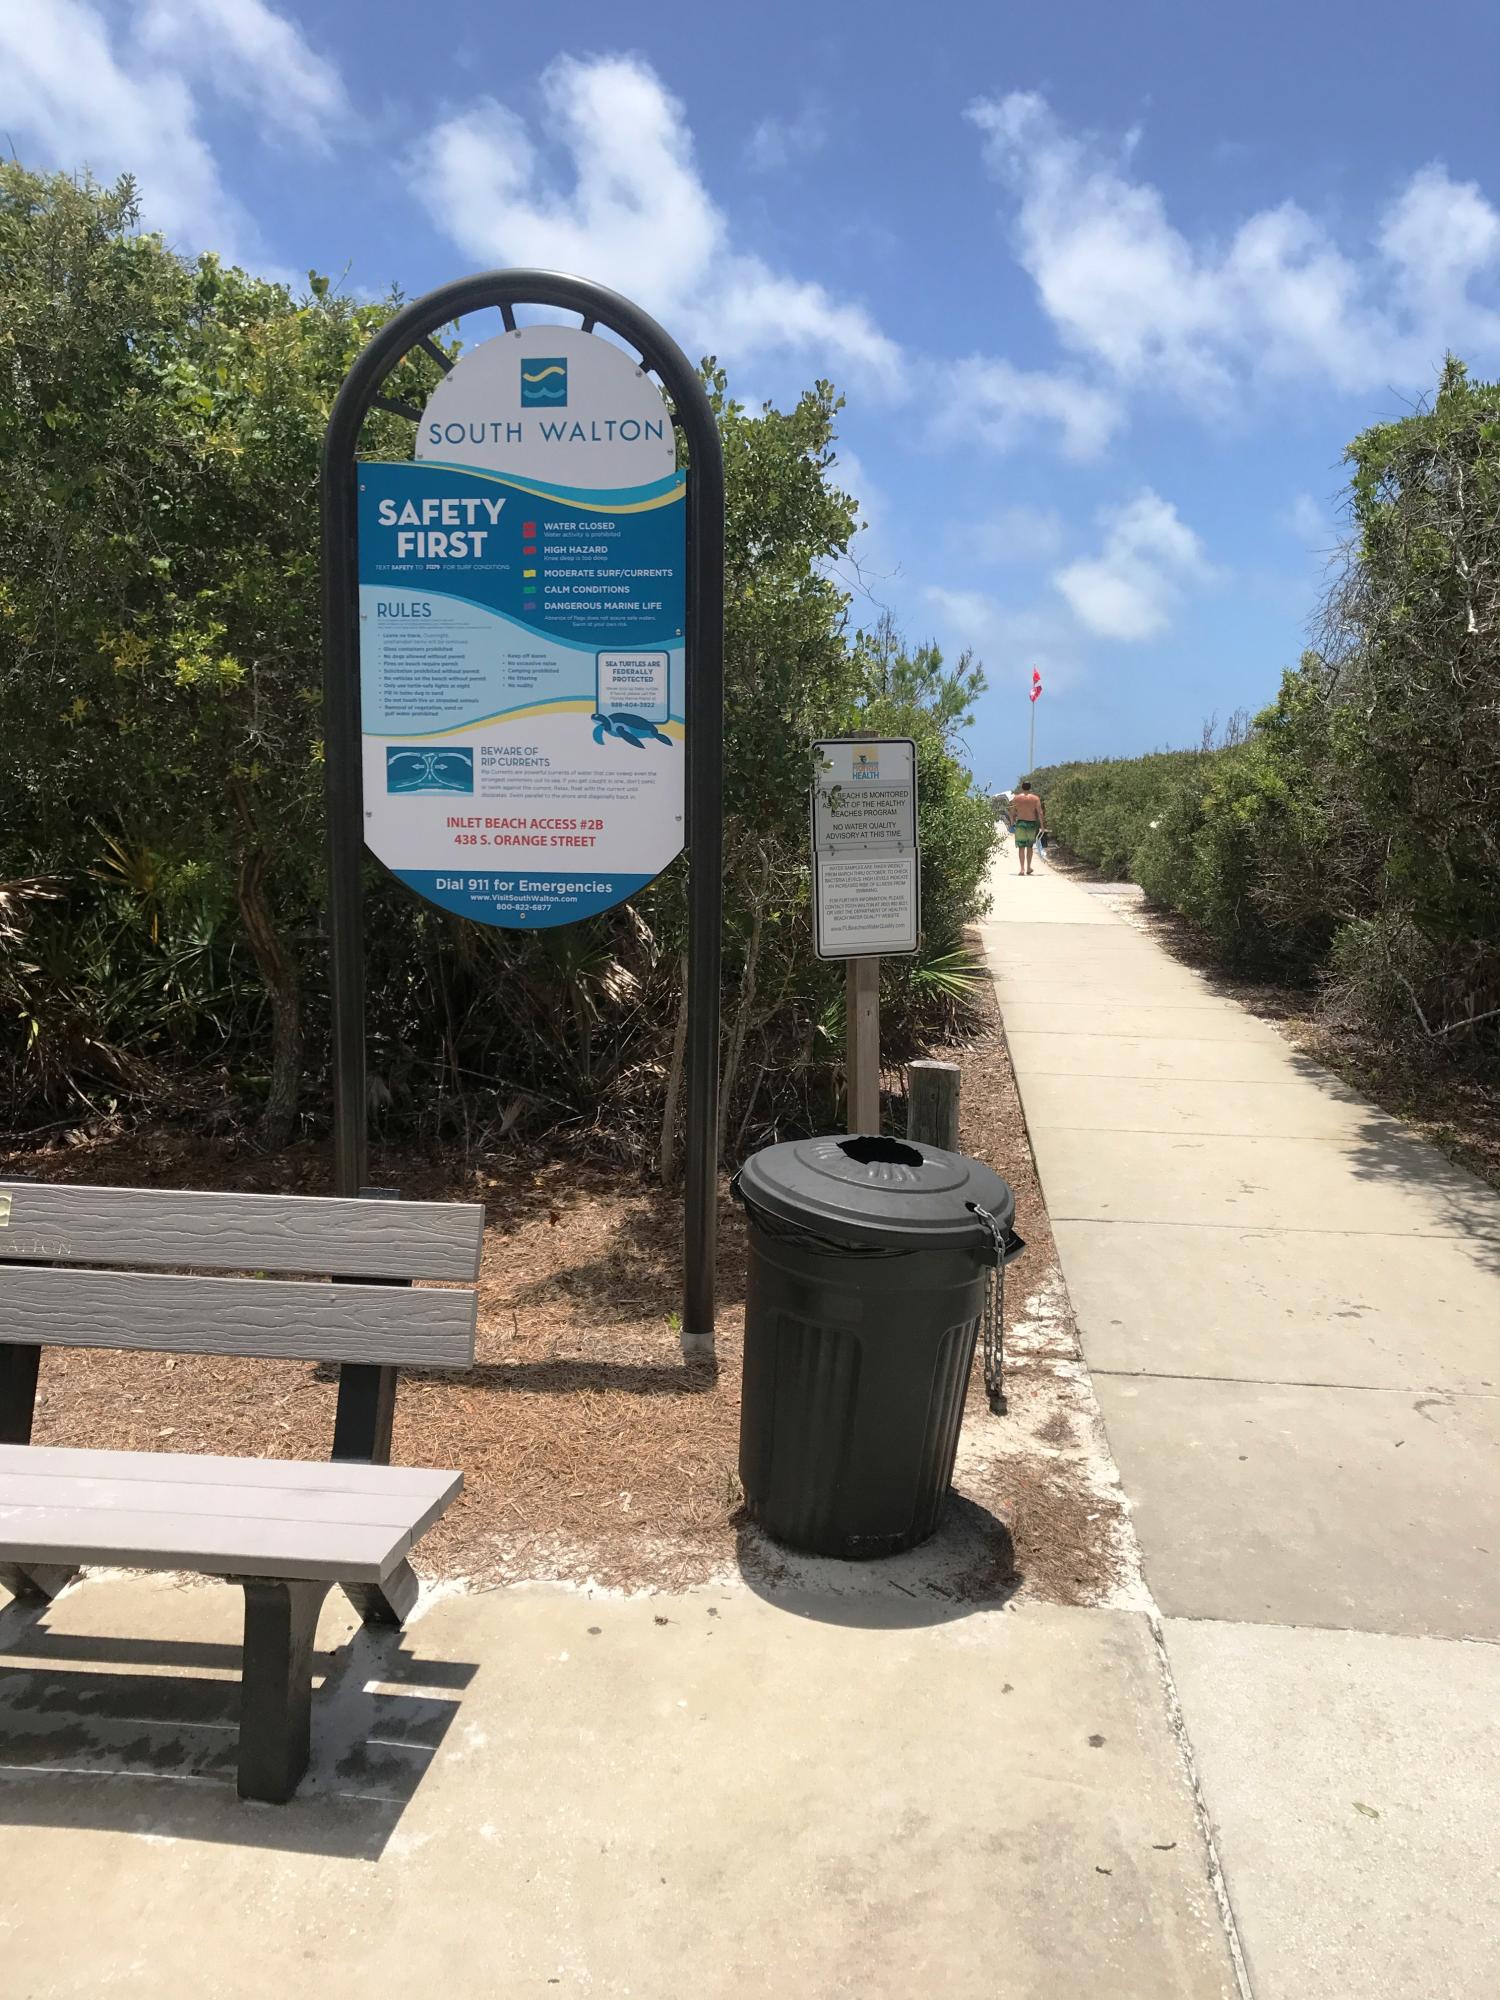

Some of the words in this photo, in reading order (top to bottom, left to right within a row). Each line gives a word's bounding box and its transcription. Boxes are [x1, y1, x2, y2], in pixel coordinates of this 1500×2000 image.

[429, 422, 522, 445] SOUTH
[540, 419, 663, 442] WALTON
[378, 498, 506, 526] SAFETY
[544, 522, 576, 530] WATER
[578, 522, 615, 530] CLOSED
[398, 531, 488, 558] FIRST
[544, 546, 567, 554] HIGH
[569, 546, 608, 554] HAZARD
[544, 569, 594, 577] MODERATE
[597, 569, 673, 578] SURF/CURRENTS
[377, 603, 432, 617] RULES
[544, 602, 602, 610] DANGEROUS
[604, 602, 639, 610] MARINE
[642, 602, 662, 610] LIFE
[481, 746, 522, 756] BEWARE
[524, 746, 539, 756] OF
[481, 757, 496, 767] RIP
[498, 757, 551, 767] CURRENTS
[447, 817, 482, 828] INLET
[485, 818, 527, 829] BEACH
[530, 818, 577, 830] ACCESS
[580, 819, 603, 830] #2B
[454, 835, 477, 845] 438
[480, 835, 491, 845] S.
[494, 835, 547, 846] ORANGE
[550, 836, 596, 847] STREET
[826, 832, 859, 840] ADVISORY
[436, 878, 463, 890] Dial
[468, 879, 488, 891] 911
[494, 879, 514, 891] for
[519, 880, 612, 894] Emergencies
[470, 894, 577, 903] www.VisitSouthWalton.com
